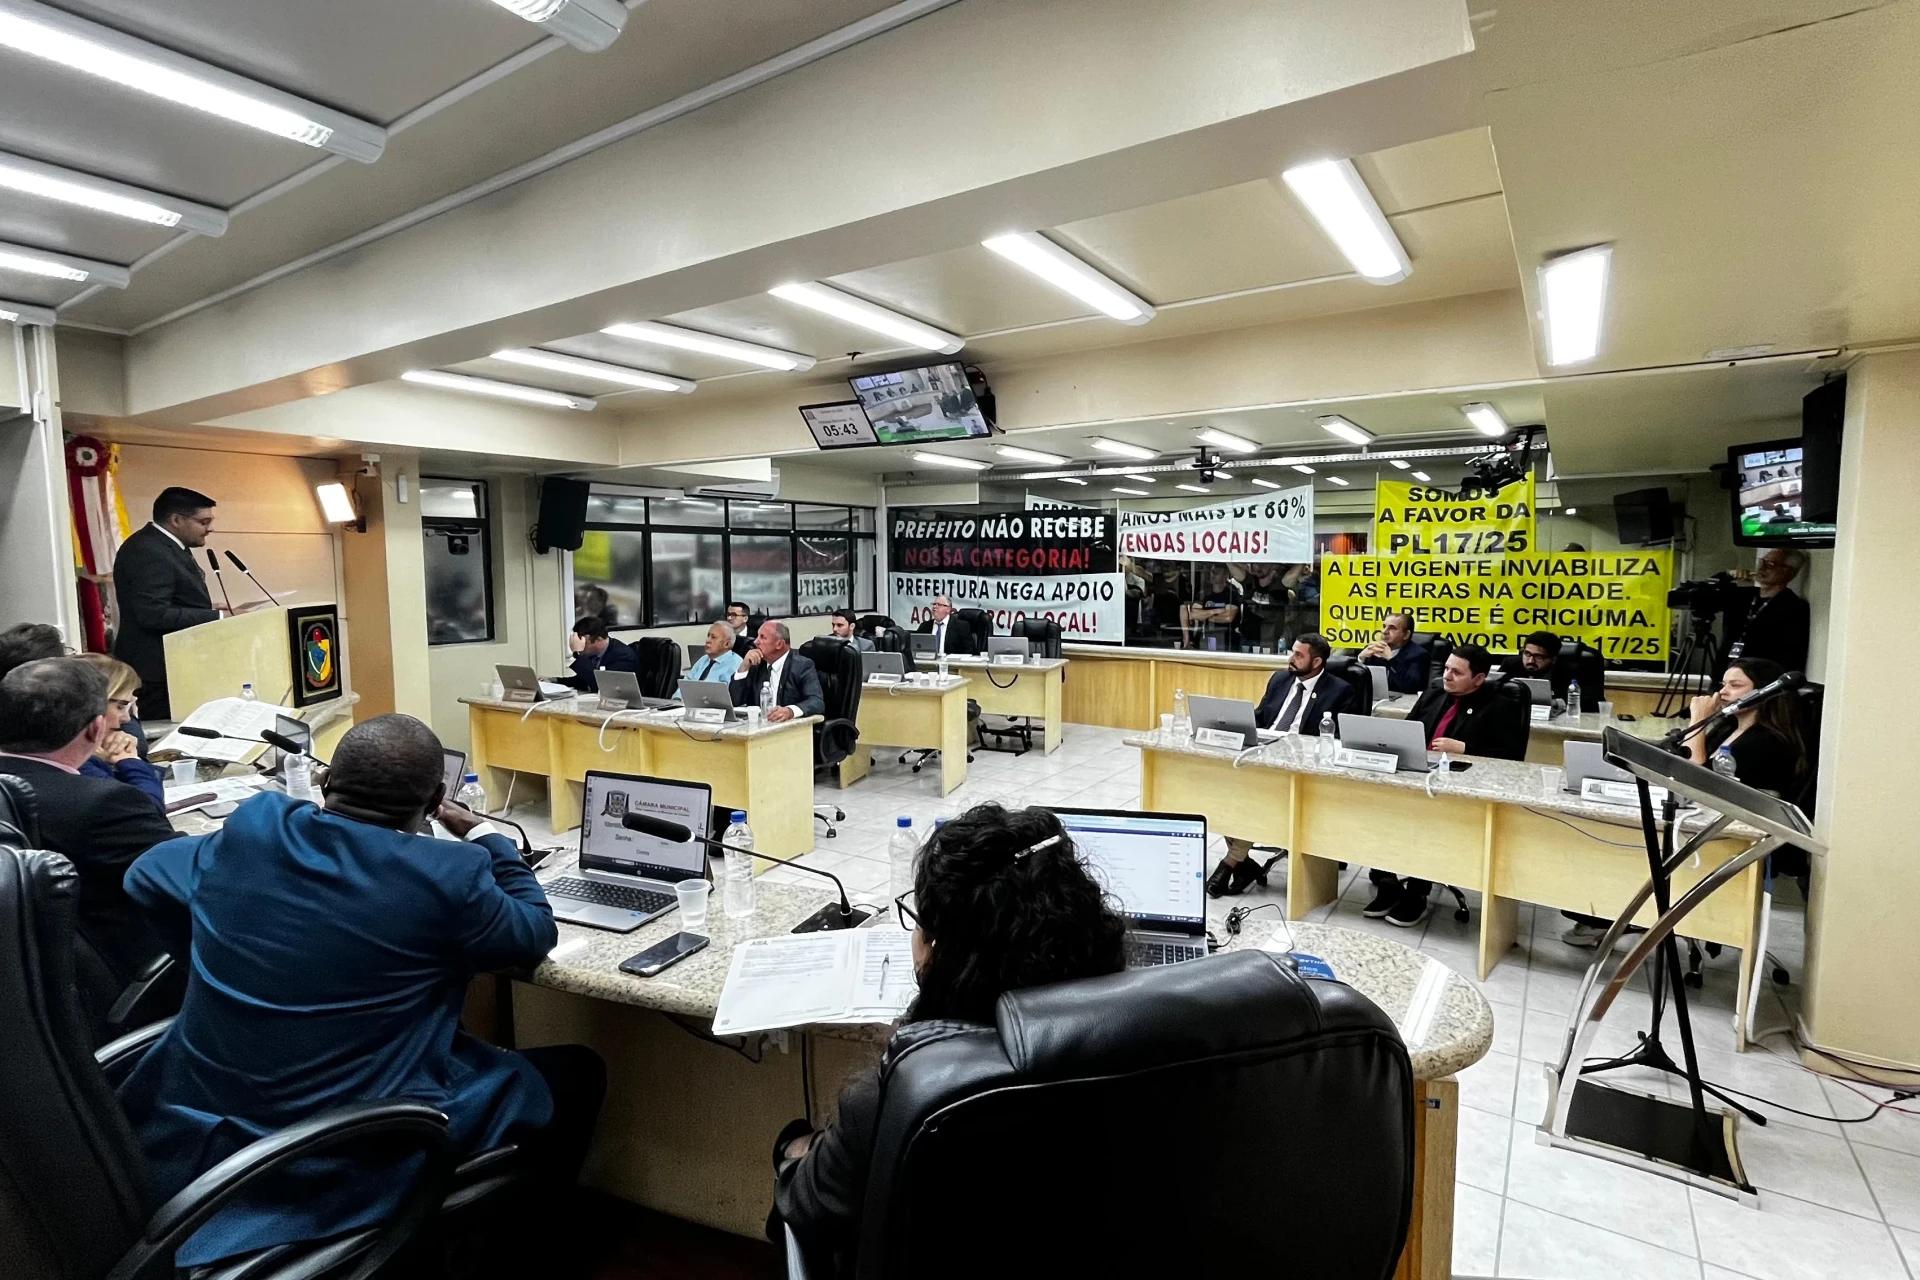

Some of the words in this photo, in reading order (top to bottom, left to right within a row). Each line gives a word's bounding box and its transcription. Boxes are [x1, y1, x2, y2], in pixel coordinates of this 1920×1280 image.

[823, 423, 858, 437] 05:43
[1233, 504, 1258, 518] DE
[1265, 494, 1306, 519] 60%
[1379, 508, 1395, 523] A
[1404, 507, 1486, 523] FAVOR
[1496, 502, 1531, 519] DA
[894, 520, 976, 539] PREFEITO
[981, 514, 1024, 539] NÃO
[1031, 517, 1105, 538] RECEBE
[1192, 530, 1268, 554] LOCAIS!
[905, 548, 964, 568] NOSSA
[971, 547, 1090, 569] CATEGORIA!
[1328, 561, 1342, 576] A
[1350, 561, 1381, 577] LEI
[1389, 560, 1492, 577] VIGENTE
[1501, 558, 1660, 577] INVIABILIZA
[897, 577, 989, 599] PREFEITURA
[997, 581, 1045, 600] NEGA
[1052, 581, 1114, 601] APOIO
[1348, 582, 1377, 598] AS
[1386, 583, 1470, 599] FEIRAS
[1480, 583, 1514, 599] NA
[1521, 582, 1631, 600] CIDADE.
[911, 606, 933, 624] AO
[1330, 605, 1392, 622] QUEM
[1402, 607, 1480, 624] PERDE
[1490, 603, 1504, 625] É
[1513, 604, 1655, 627] CRICIÚMA.
[1445, 632, 1508, 649] AVOR
